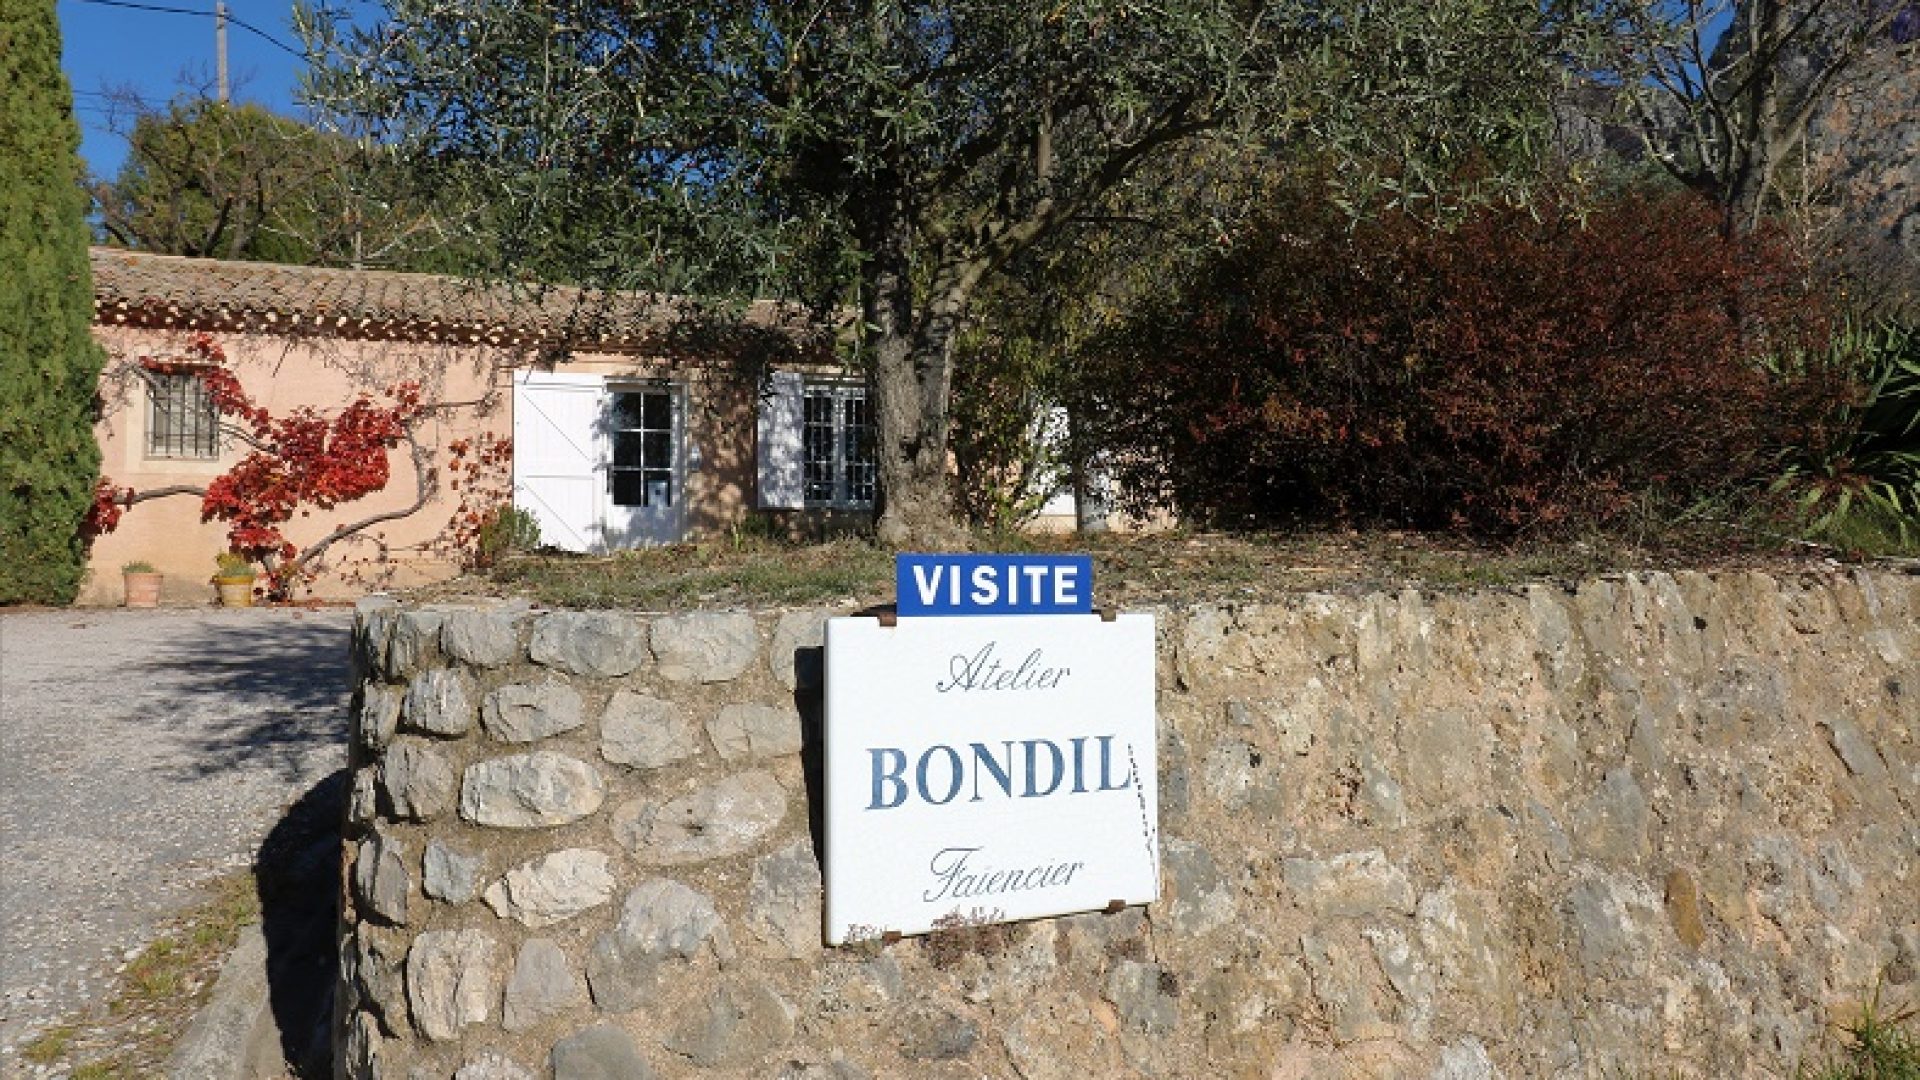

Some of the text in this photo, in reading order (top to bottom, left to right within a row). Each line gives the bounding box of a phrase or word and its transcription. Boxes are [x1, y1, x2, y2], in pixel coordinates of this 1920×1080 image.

[913, 565, 1078, 605] VISITE
[935, 640, 1071, 693] Atelier
[863, 734, 1131, 812] BONDIL
